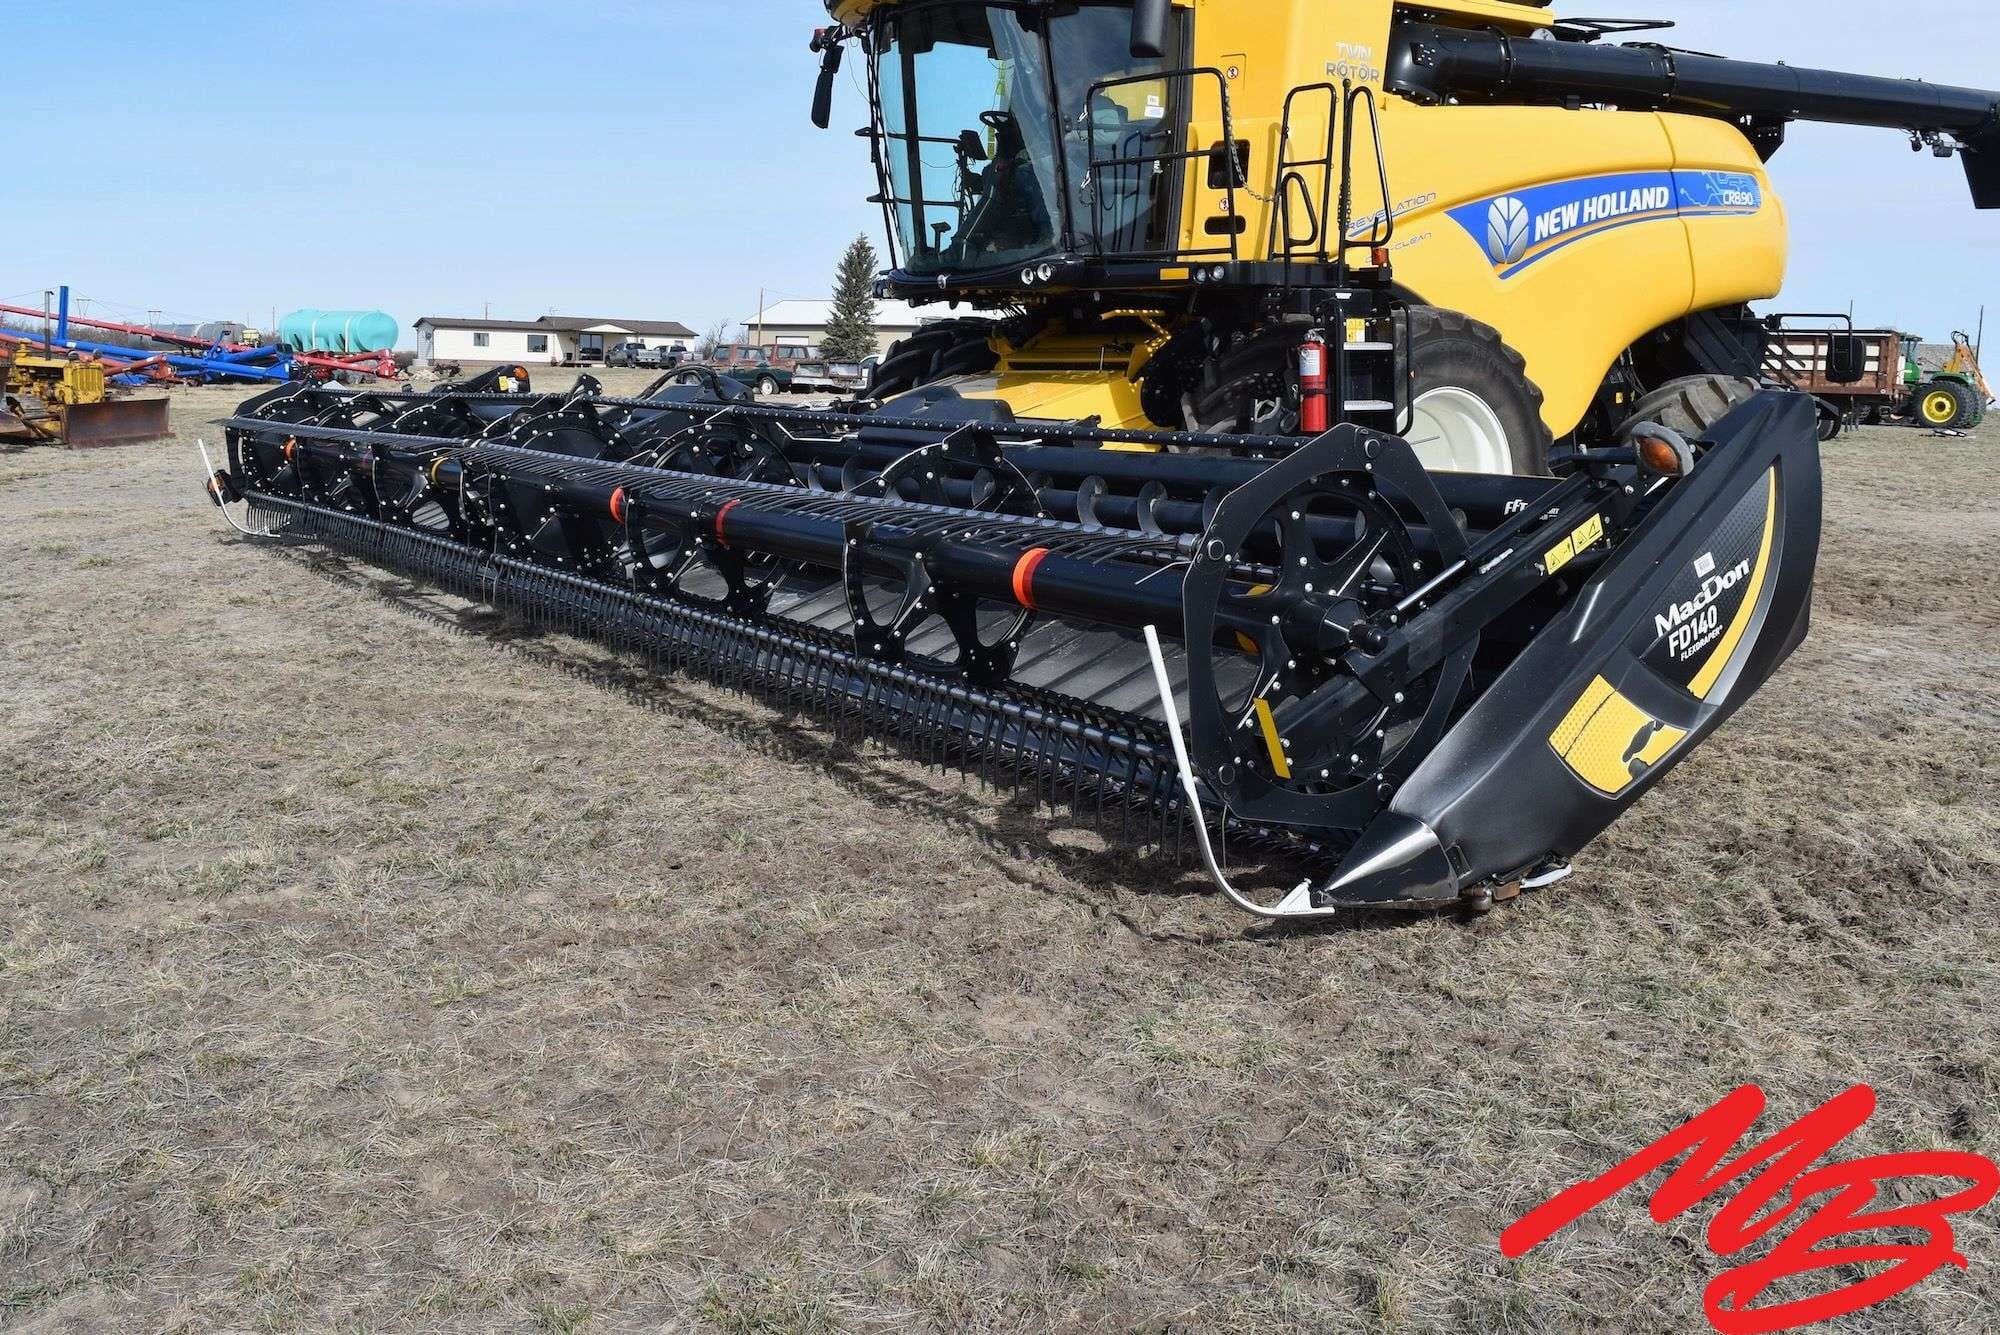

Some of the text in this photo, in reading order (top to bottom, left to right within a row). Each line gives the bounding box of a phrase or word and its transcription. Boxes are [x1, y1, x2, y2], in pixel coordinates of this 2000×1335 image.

[1326, 60, 1379, 82] ROTOR
[1335, 41, 1372, 60] TWIN
[1345, 192, 1437, 230] REVEATION
[1534, 186, 1670, 242] NEW HOLLAND
[1654, 558, 1749, 637] MacDon
[1668, 604, 1718, 658] FD140
